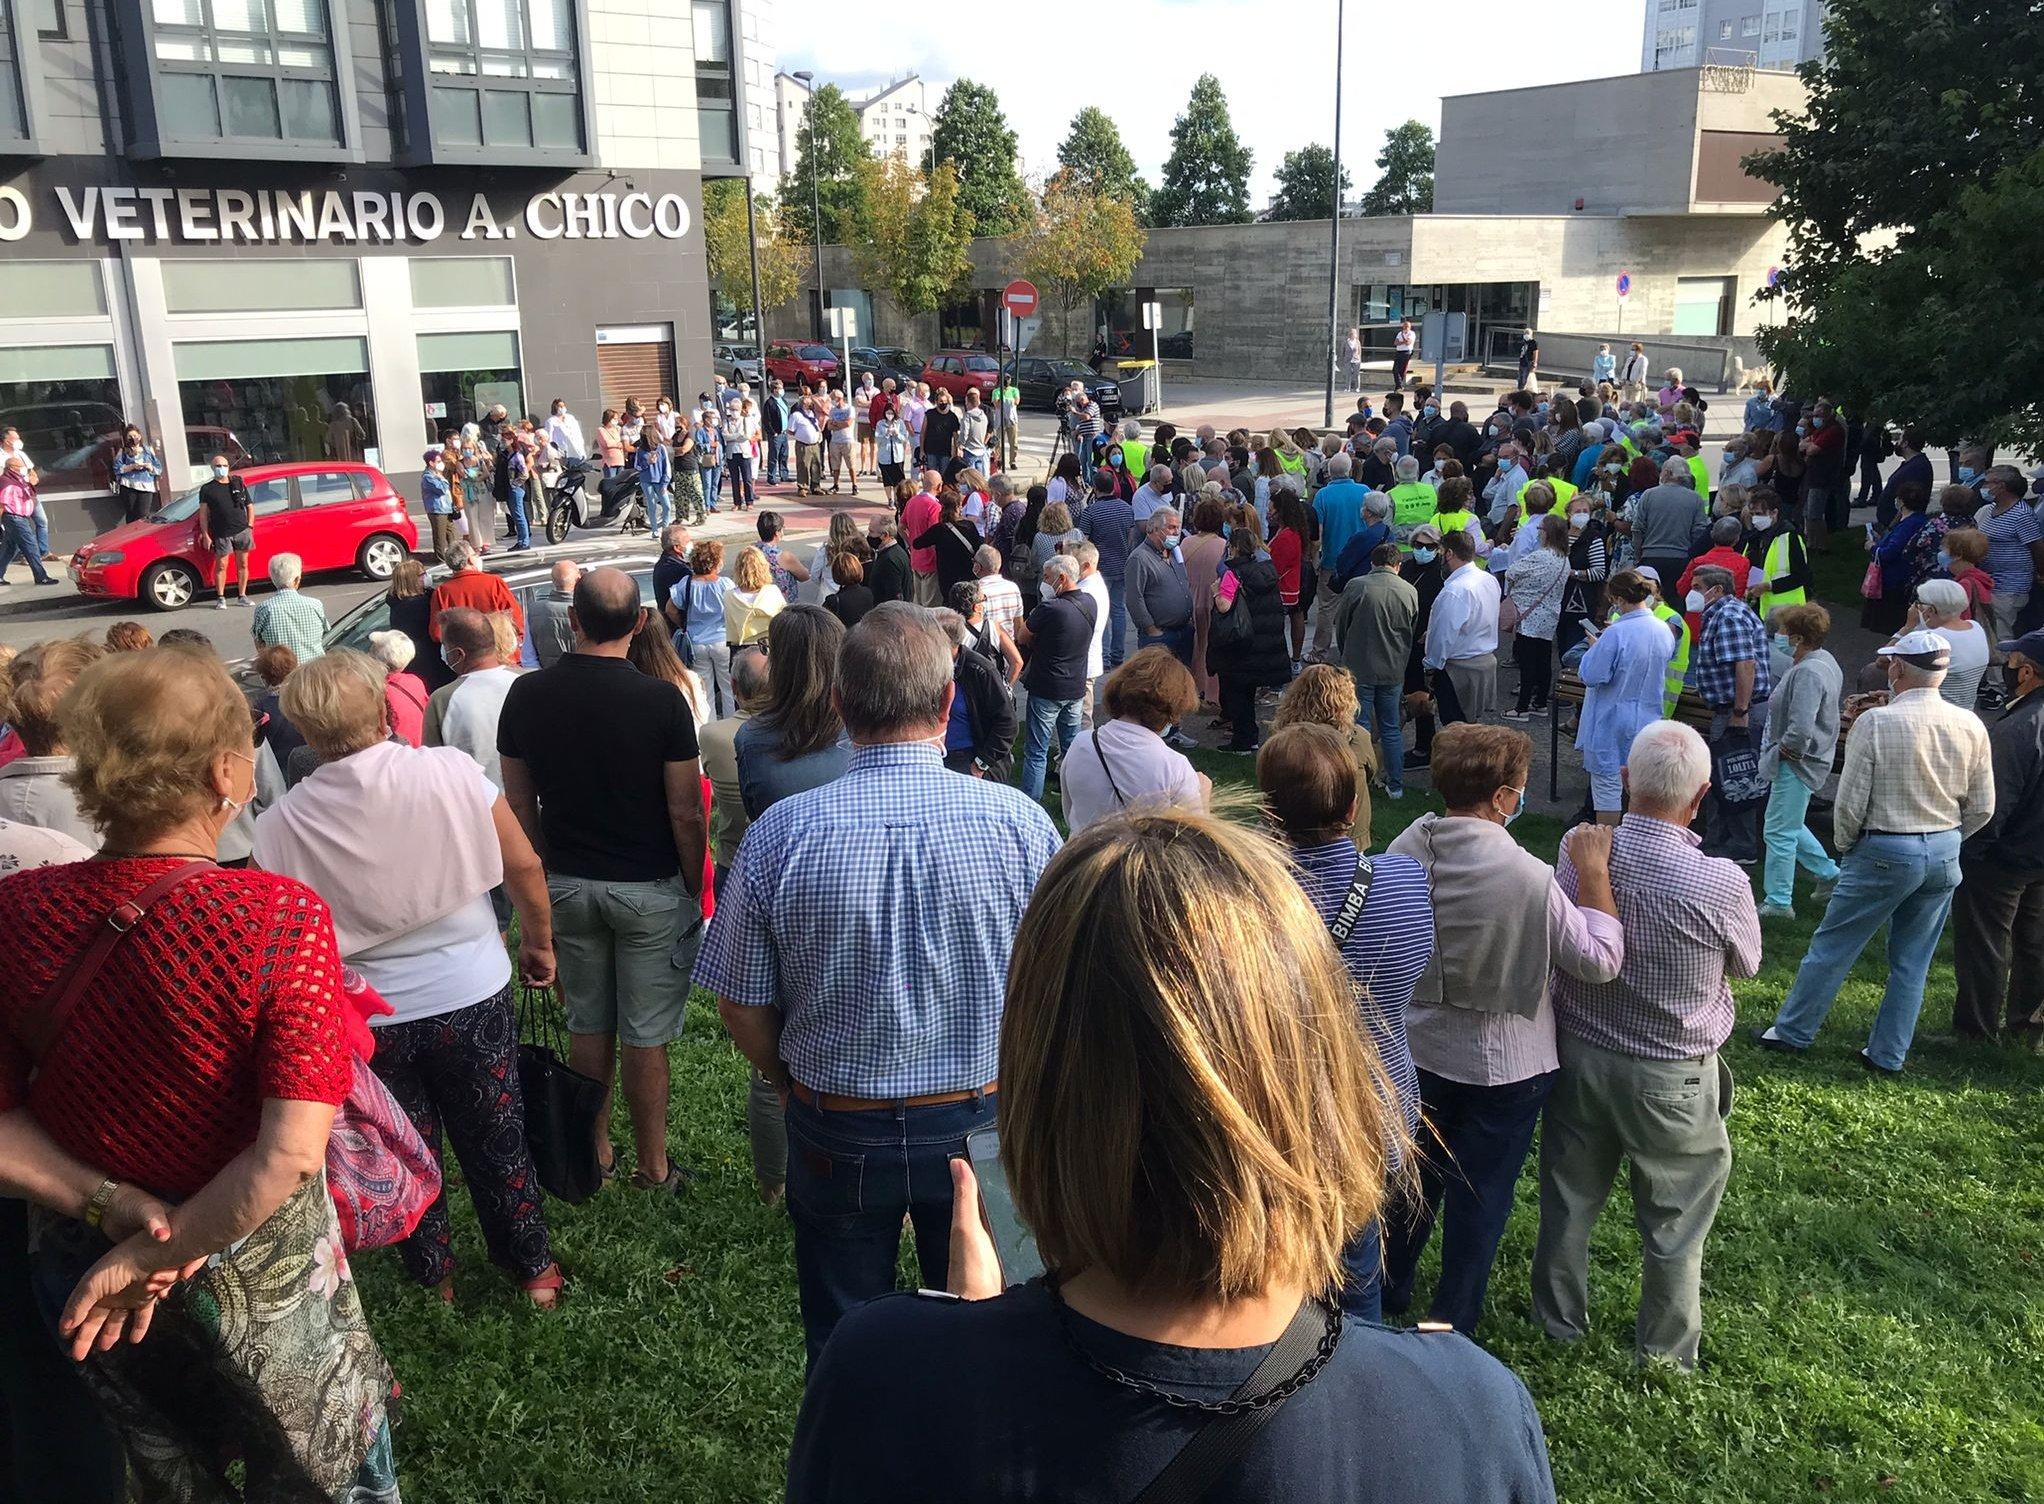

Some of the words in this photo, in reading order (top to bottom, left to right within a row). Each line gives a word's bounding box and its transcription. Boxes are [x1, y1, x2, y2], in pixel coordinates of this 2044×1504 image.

[54, 186, 445, 241] VETERINARIO
[461, 192, 516, 239] A.
[526, 191, 691, 239] CHICO
[1331, 882, 1369, 940] BIMBA
